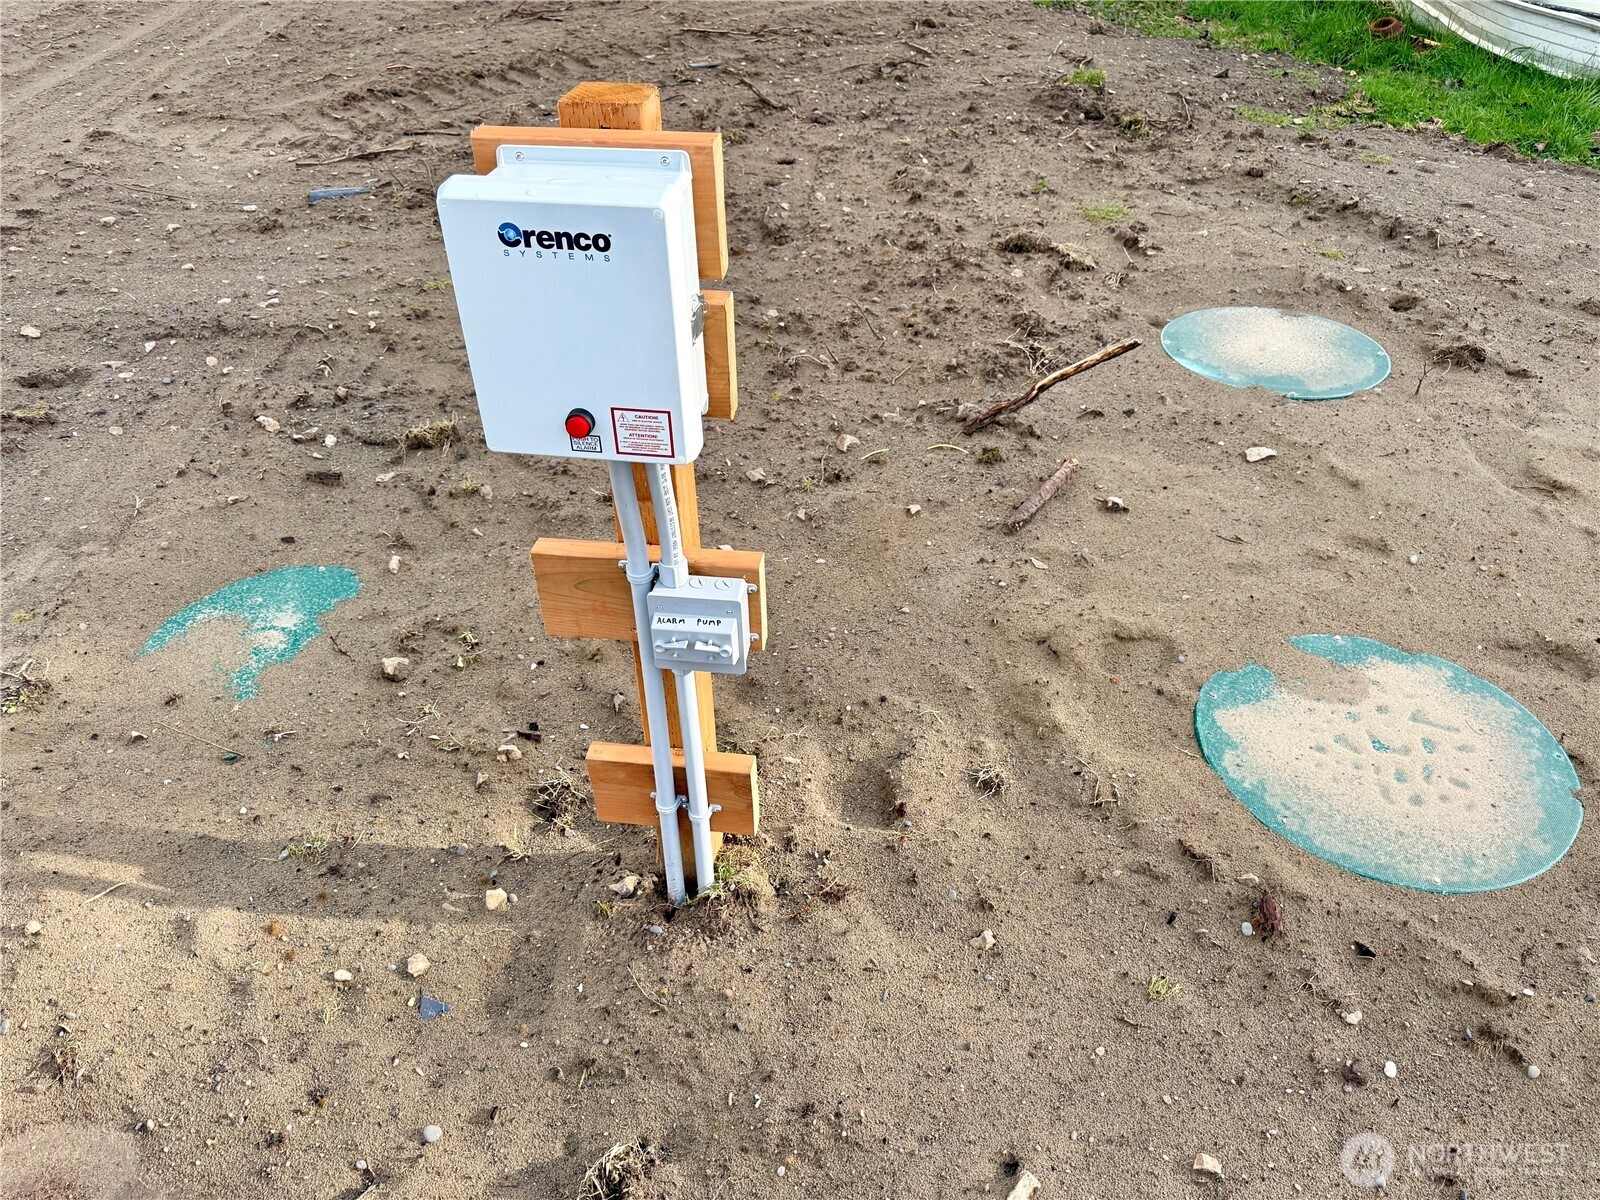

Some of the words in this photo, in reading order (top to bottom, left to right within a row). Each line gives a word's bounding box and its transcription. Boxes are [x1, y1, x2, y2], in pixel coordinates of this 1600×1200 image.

[498, 222, 611, 252] Orenco
[503, 249, 611, 262] SYSTEMS
[656, 617, 686, 625] ALARM
[696, 618, 722, 627] PUMP
